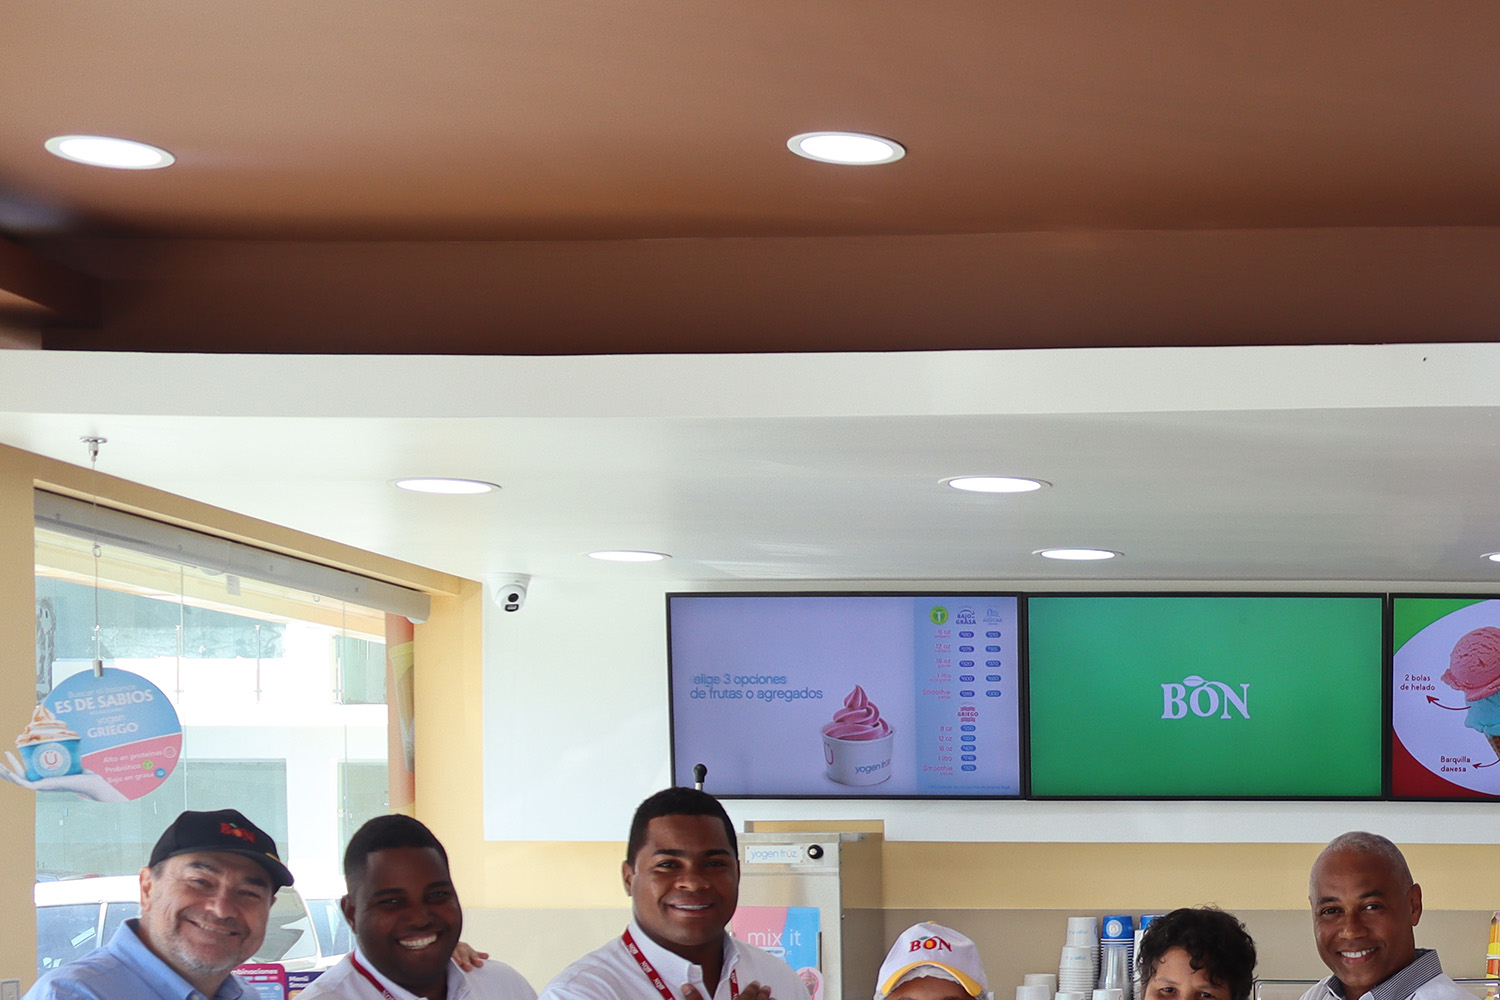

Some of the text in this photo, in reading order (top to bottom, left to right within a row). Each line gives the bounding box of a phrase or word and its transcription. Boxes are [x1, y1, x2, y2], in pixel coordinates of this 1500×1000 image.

[693, 674, 787, 687] elige 3 opciones
[1404, 674, 1431, 682] 2 bolas
[690, 687, 823, 702] de frutas o agregados
[1411, 683, 1436, 691] helado
[54, 700, 72, 714] ES
[74, 698, 96, 711] DE
[97, 689, 154, 708] SABIOS
[1160, 678, 1250, 720] BON
[87, 722, 138, 738] GRIEGO
[1440, 756, 1471, 764] Barquilla
[751, 850, 778, 859] yogen
[747, 929, 801, 946] mix it
[908, 935, 952, 953] BON
